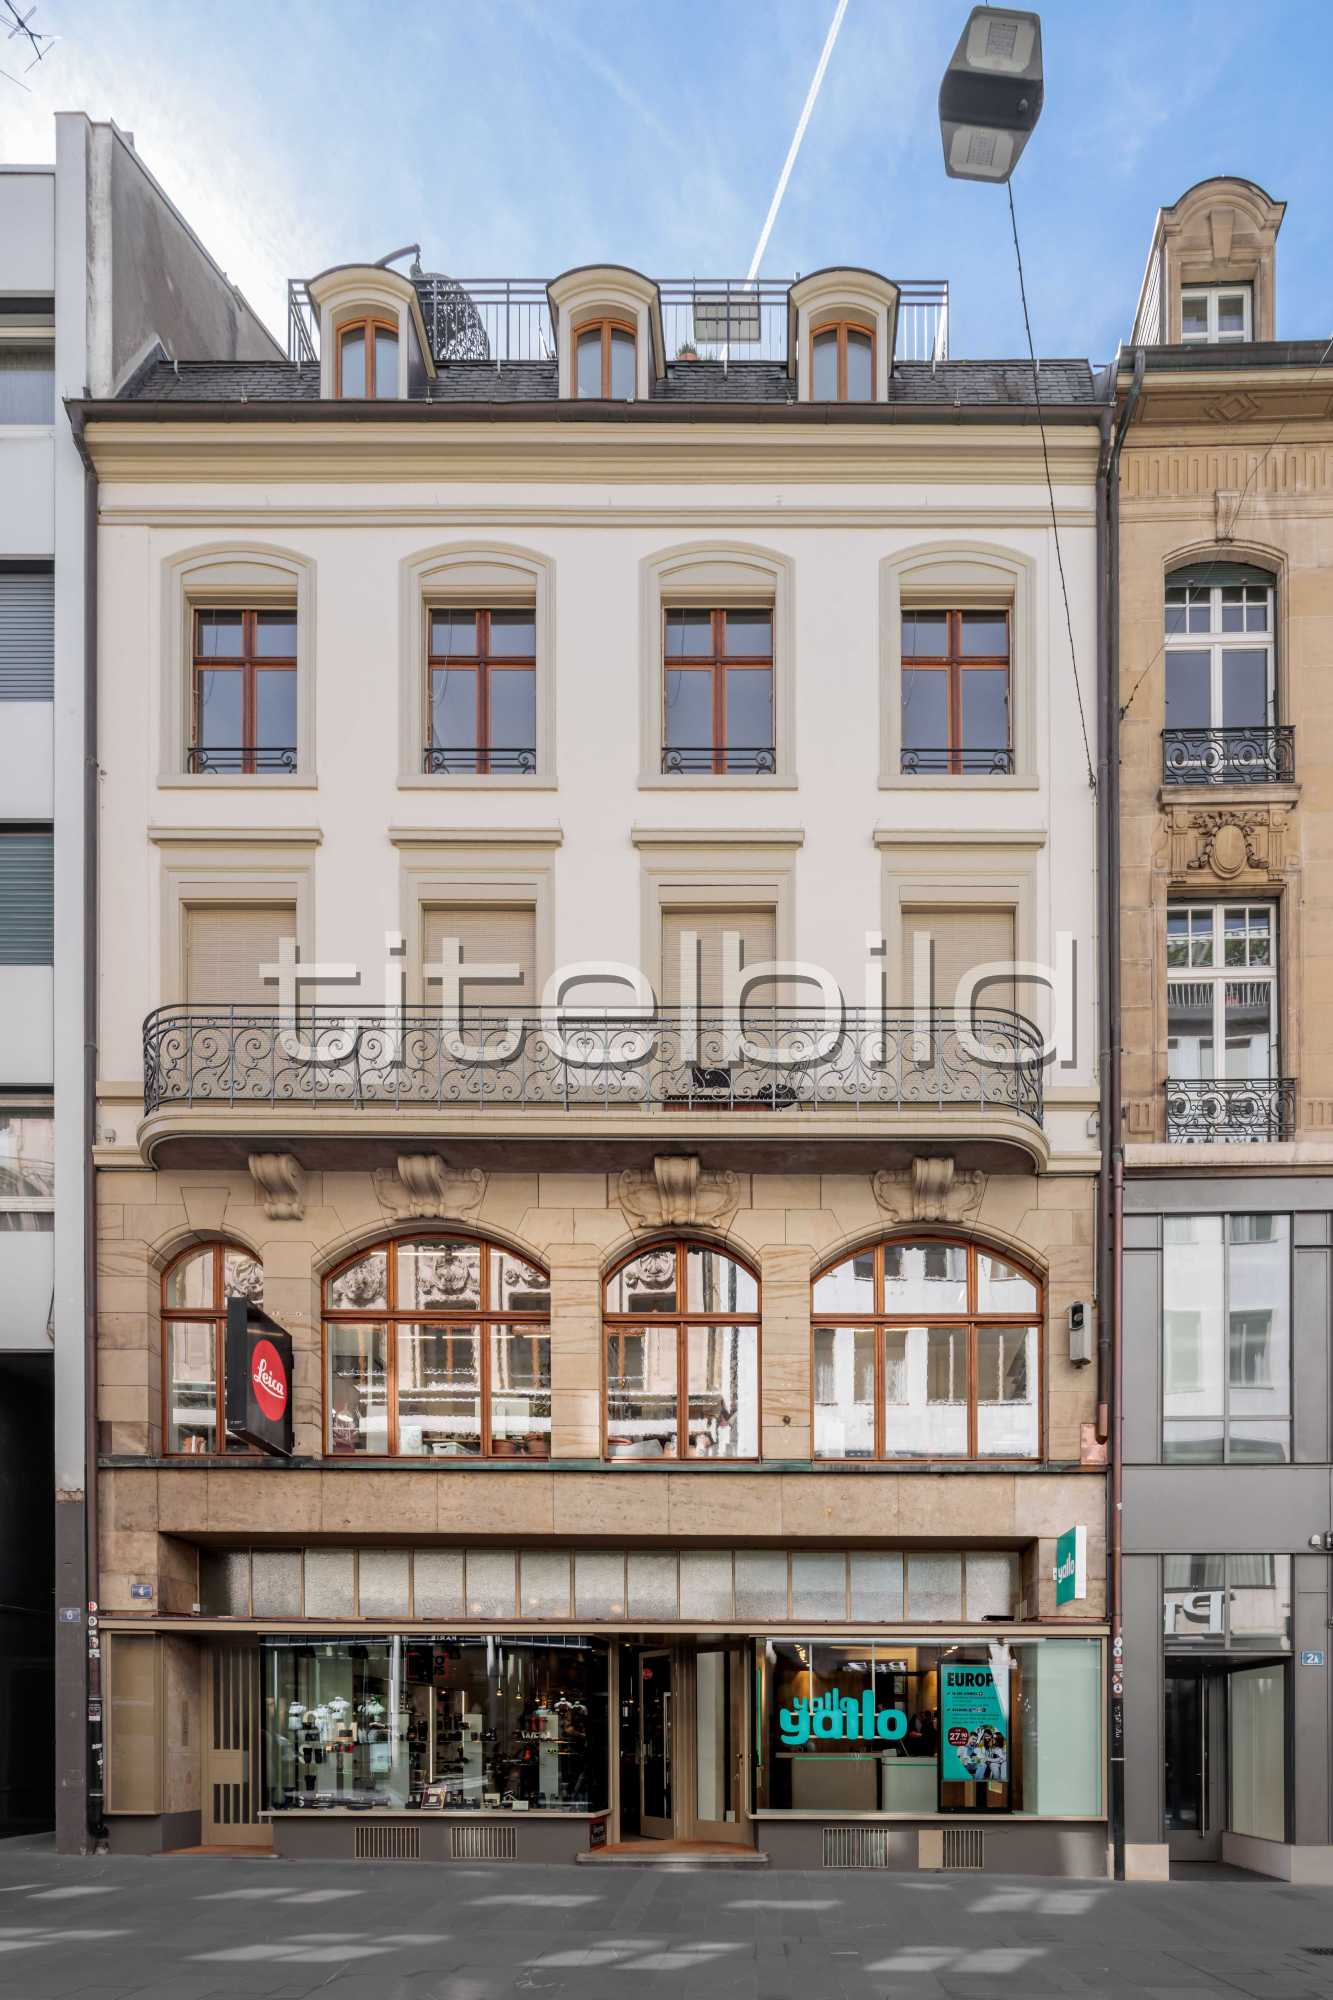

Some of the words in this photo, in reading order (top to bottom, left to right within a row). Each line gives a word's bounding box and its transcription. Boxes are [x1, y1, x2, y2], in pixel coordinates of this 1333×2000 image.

[253, 1358, 285, 1398] Leica
[1058, 1552, 1075, 1585] yallo
[66, 1610, 73, 1620] 6
[947, 1672, 1003, 1687] EUROP
[780, 1689, 908, 1745] yallo
